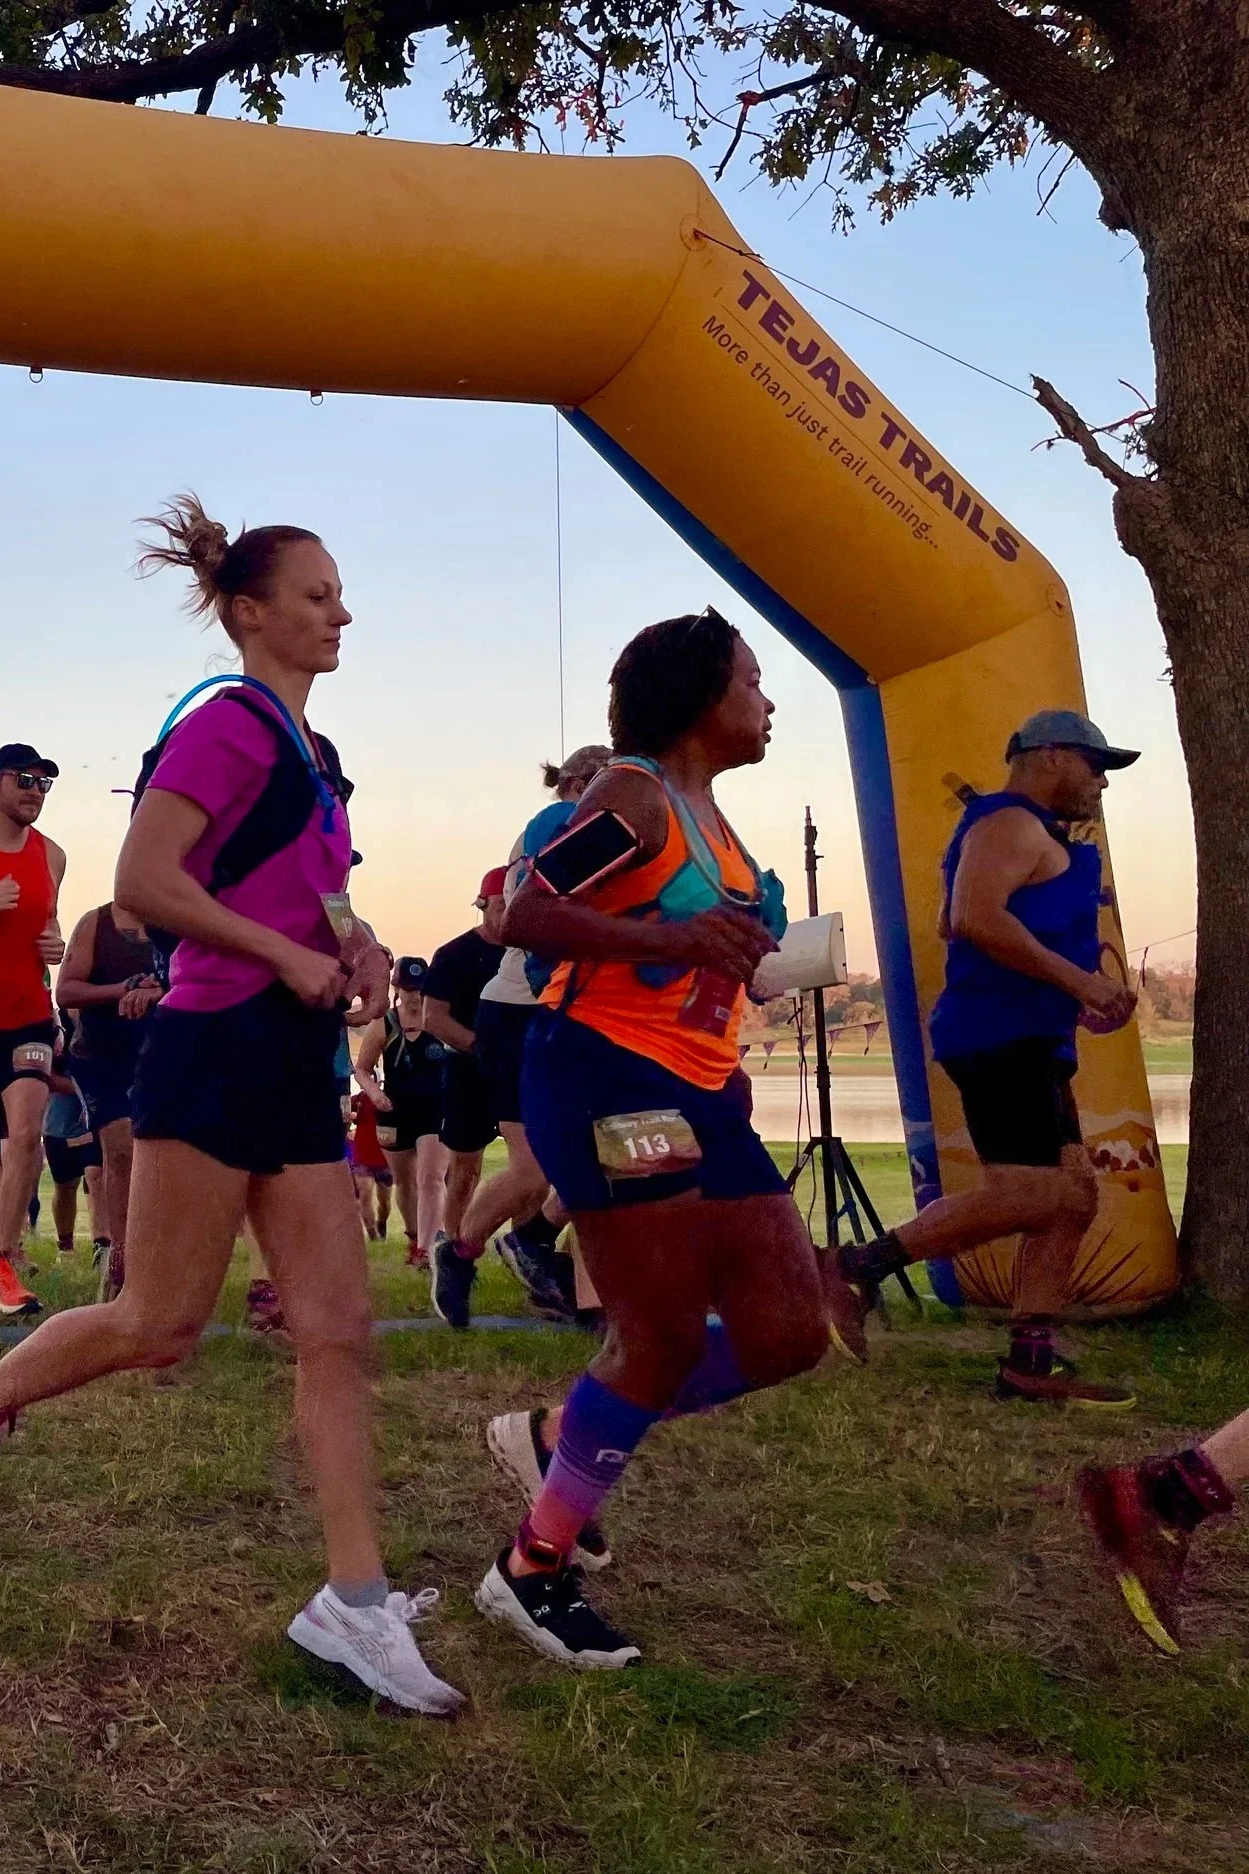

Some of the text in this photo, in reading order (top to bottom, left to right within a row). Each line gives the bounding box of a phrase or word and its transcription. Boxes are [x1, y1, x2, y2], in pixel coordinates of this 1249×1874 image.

[702, 315, 938, 549] More than just trail running...
[737, 269, 1020, 562] TEJAS TRAILS
[26, 1051, 44, 1061] 101
[624, 1133, 670, 1159] 113
